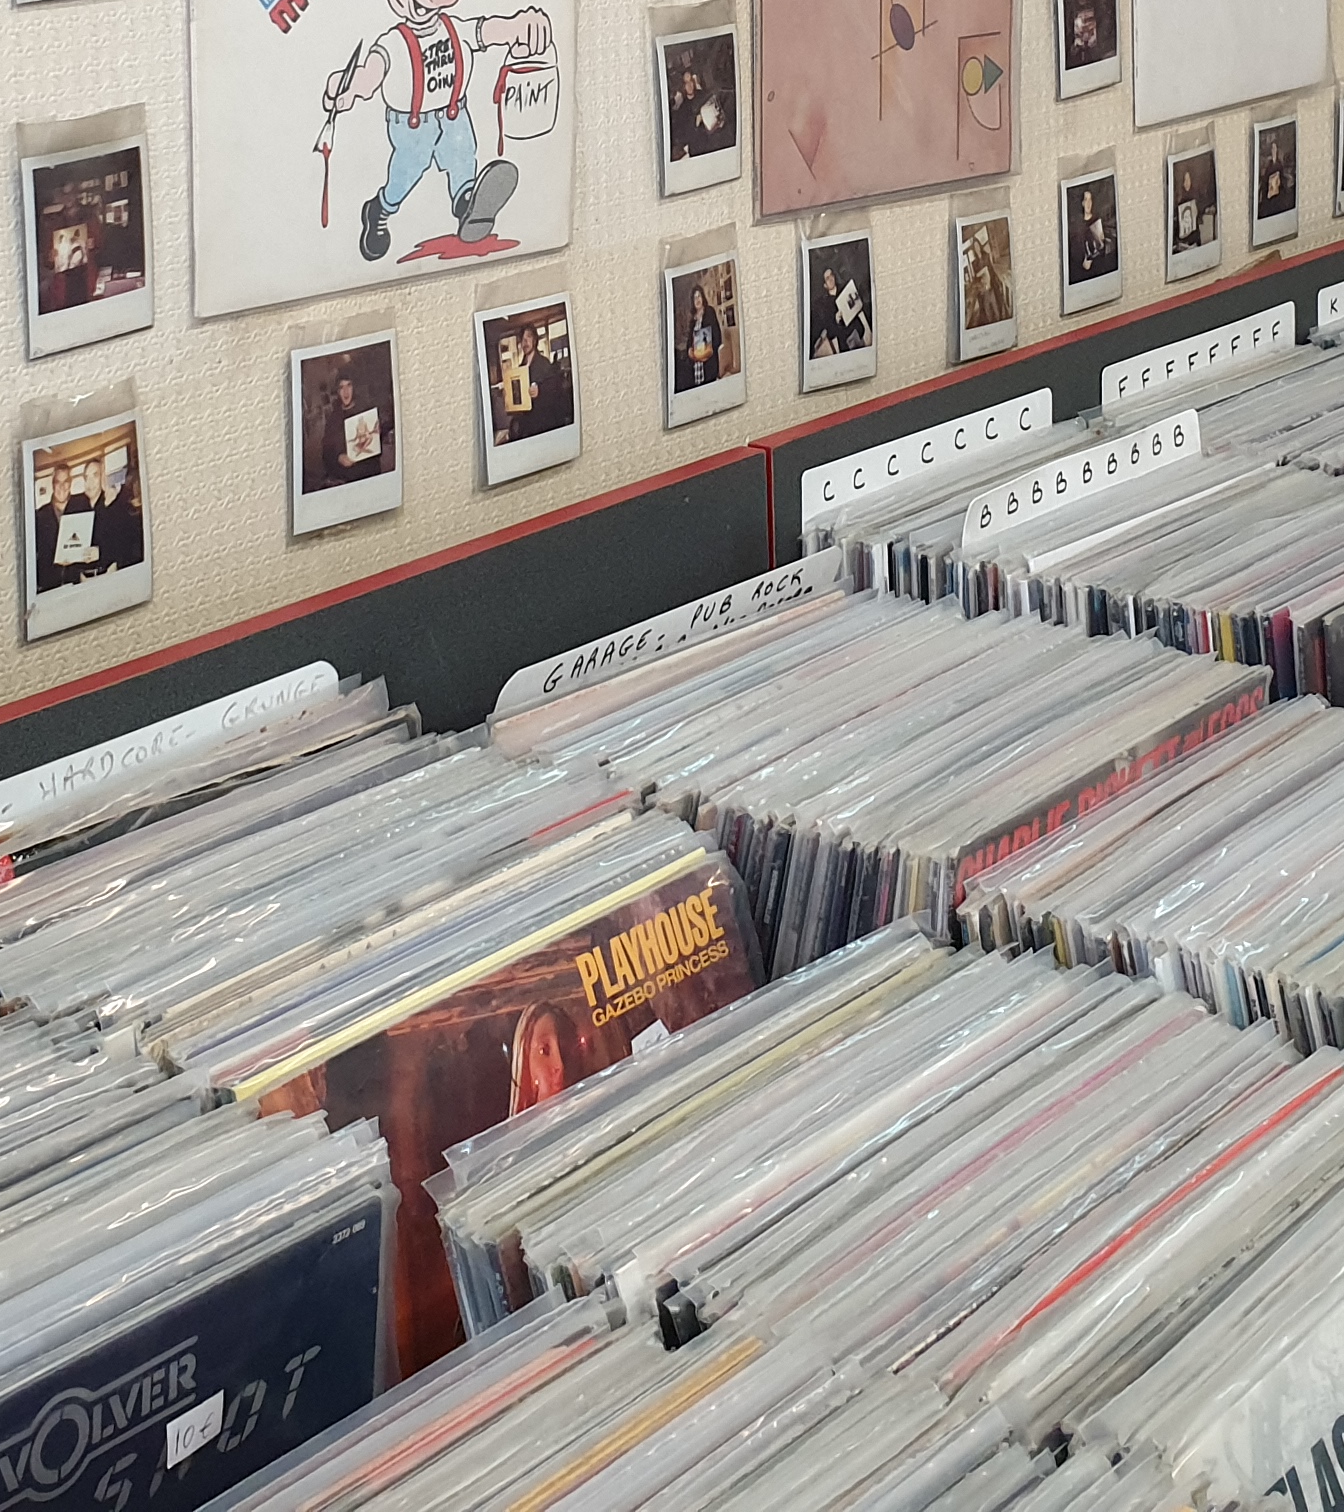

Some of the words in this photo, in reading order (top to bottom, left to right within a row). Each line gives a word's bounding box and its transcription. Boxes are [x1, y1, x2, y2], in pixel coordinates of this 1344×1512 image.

[689, 595, 733, 631] PUB
[752, 567, 806, 601] ROCK
[574, 888, 725, 1008] PLAYHOUSE
[591, 982, 656, 1027] GAZEBO
[656, 940, 729, 987] PRINCESS
